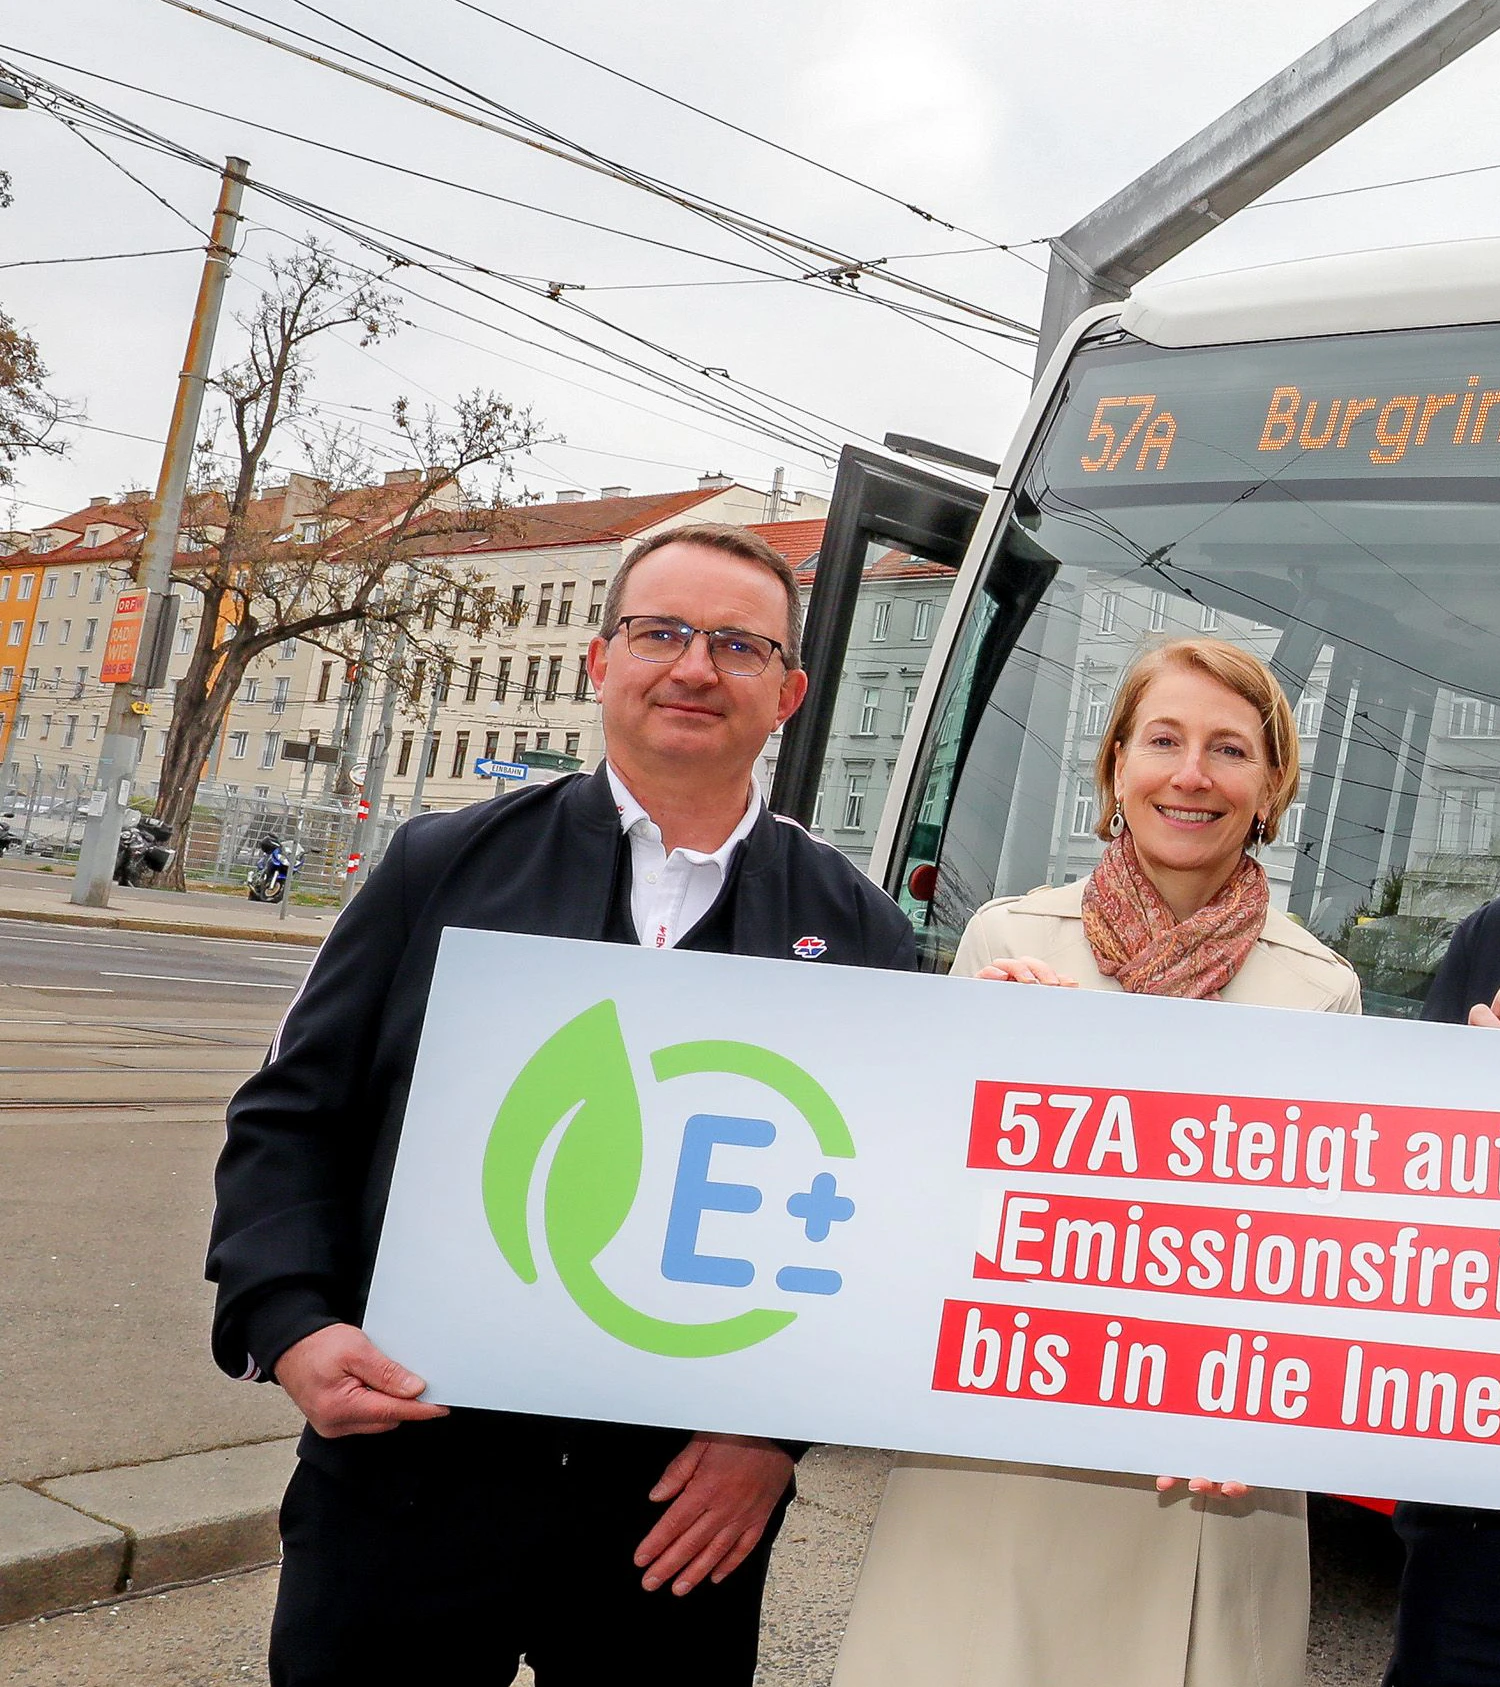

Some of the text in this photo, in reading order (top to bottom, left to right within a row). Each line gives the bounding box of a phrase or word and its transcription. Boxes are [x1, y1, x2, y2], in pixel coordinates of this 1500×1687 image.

[1081, 394, 1178, 472] 57A
[119, 599, 137, 612] ORF
[491, 764, 523, 776] EINBAHN
[996, 1091, 1139, 1174] 57A
[1167, 1103, 1380, 1204] steigt
[958, 1307, 1070, 1397] bis
[1098, 1320, 1168, 1407] in
[1197, 1333, 1312, 1420] die
